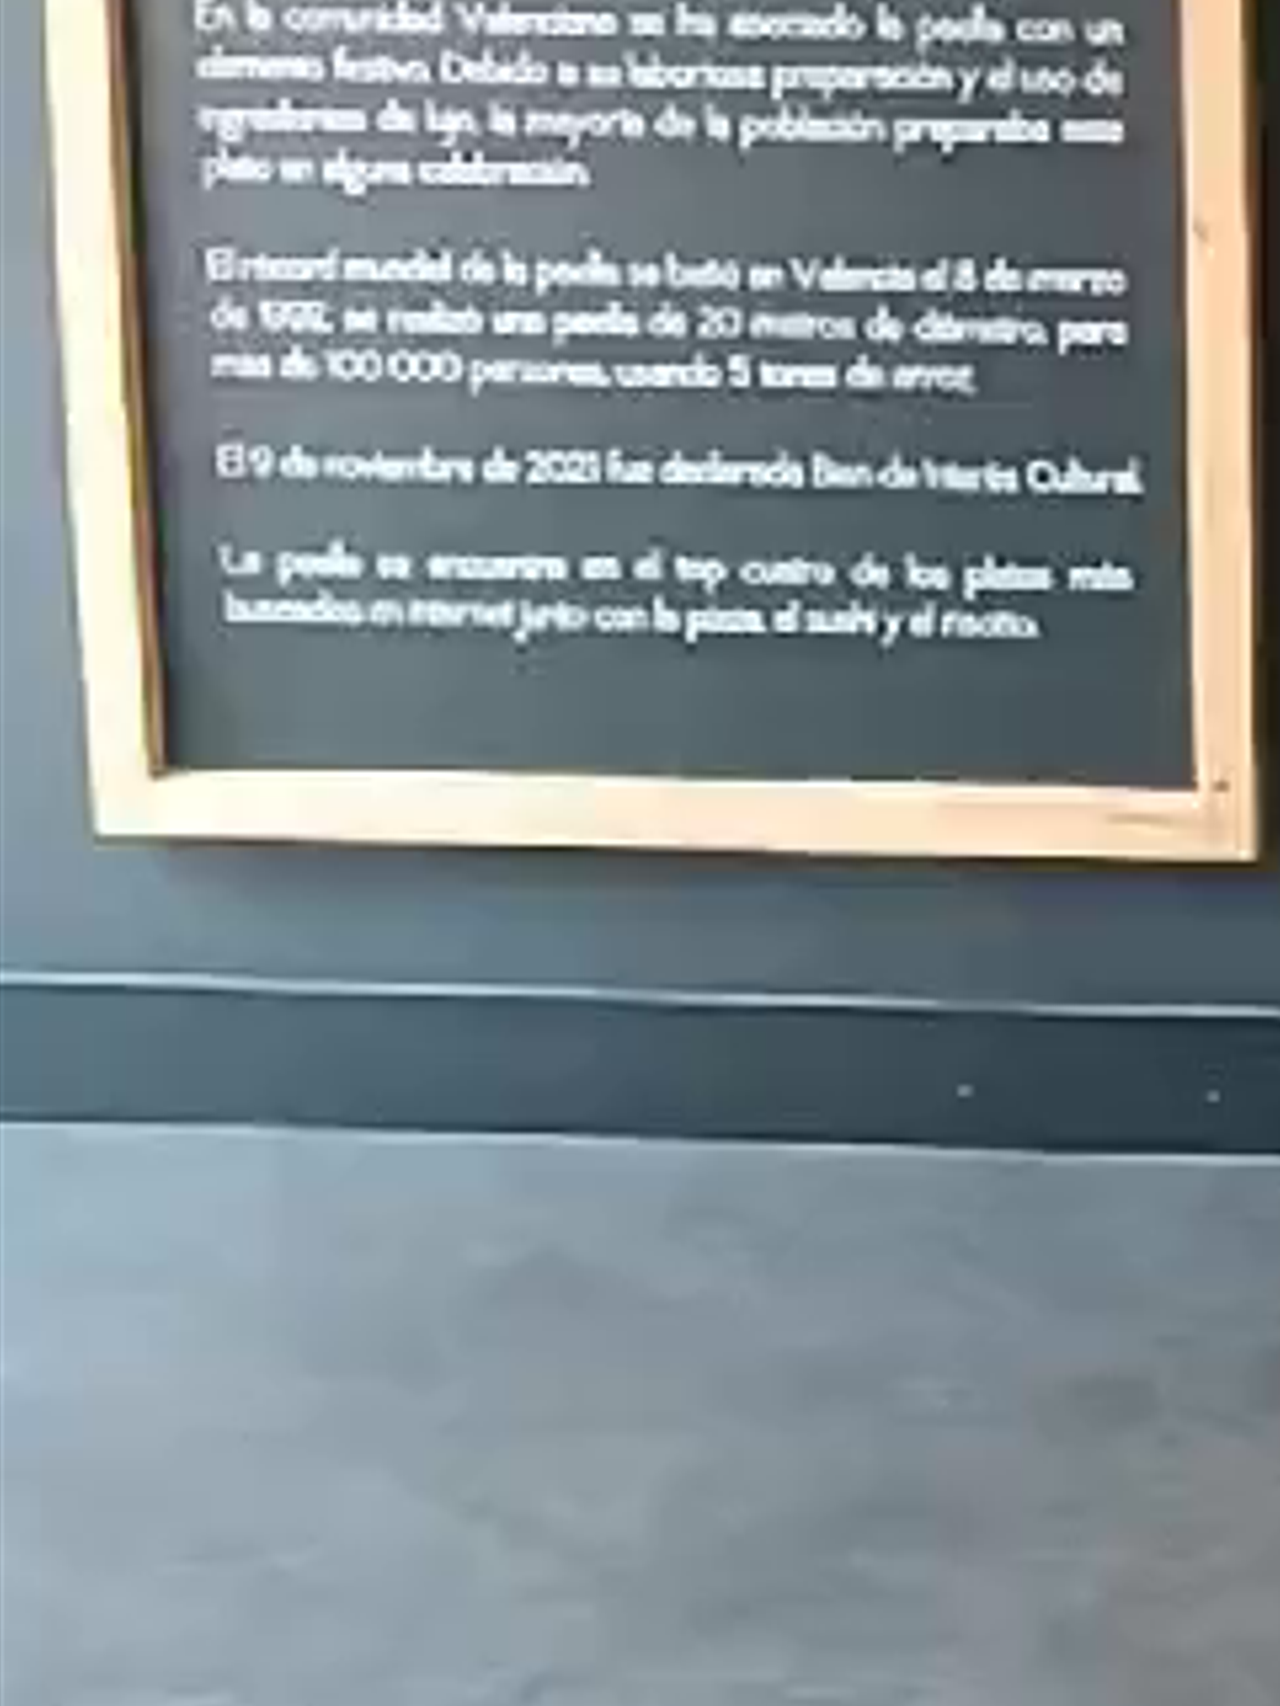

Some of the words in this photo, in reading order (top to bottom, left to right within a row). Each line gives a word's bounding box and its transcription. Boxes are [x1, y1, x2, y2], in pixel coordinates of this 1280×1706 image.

[629, 12, 666, 38] se
[676, 1, 715, 39] ha
[877, 4, 904, 42] la
[1016, 17, 1074, 44] con
[1085, 18, 1123, 45] un
[589, 63, 621, 90] su
[988, 58, 1014, 96] el
[1021, 70, 1075, 96] uso
[1084, 60, 1123, 97] de
[376, 99, 415, 136] de
[489, 101, 515, 138] la
[654, 103, 696, 141] de
[705, 104, 729, 141] la
[280, 159, 313, 186] en
[206, 246, 232, 283] El
[461, 250, 495, 287] de
[502, 251, 526, 288] la
[628, 264, 659, 290] se
[749, 266, 784, 292] en
[922, 258, 949, 295] el
[985, 259, 1022, 296] de
[210, 294, 249, 332] de
[344, 308, 376, 334] se
[493, 310, 546, 337] una
[648, 302, 686, 340] de
[697, 303, 741, 341] 20
[864, 306, 904, 343] de
[1058, 320, 1127, 358] para
[280, 346, 318, 383] de
[846, 356, 884, 393] de
[215, 441, 246, 479] El
[280, 442, 318, 480] de
[483, 446, 518, 484] de
[525, 447, 601, 485] 2021
[608, 448, 653, 486] fue
[813, 452, 872, 490] Bien
[877, 453, 917, 491] de
[219, 539, 261, 576] La
[376, 553, 411, 579] se
[580, 557, 621, 584] en
[633, 547, 663, 584] el
[675, 548, 727, 597] top
[850, 551, 888, 589] de
[904, 552, 951, 590] los
[371, 602, 403, 629] en
[594, 607, 648, 634] con
[653, 597, 680, 635] la
[774, 600, 799, 637] el
[909, 602, 936, 640] el
